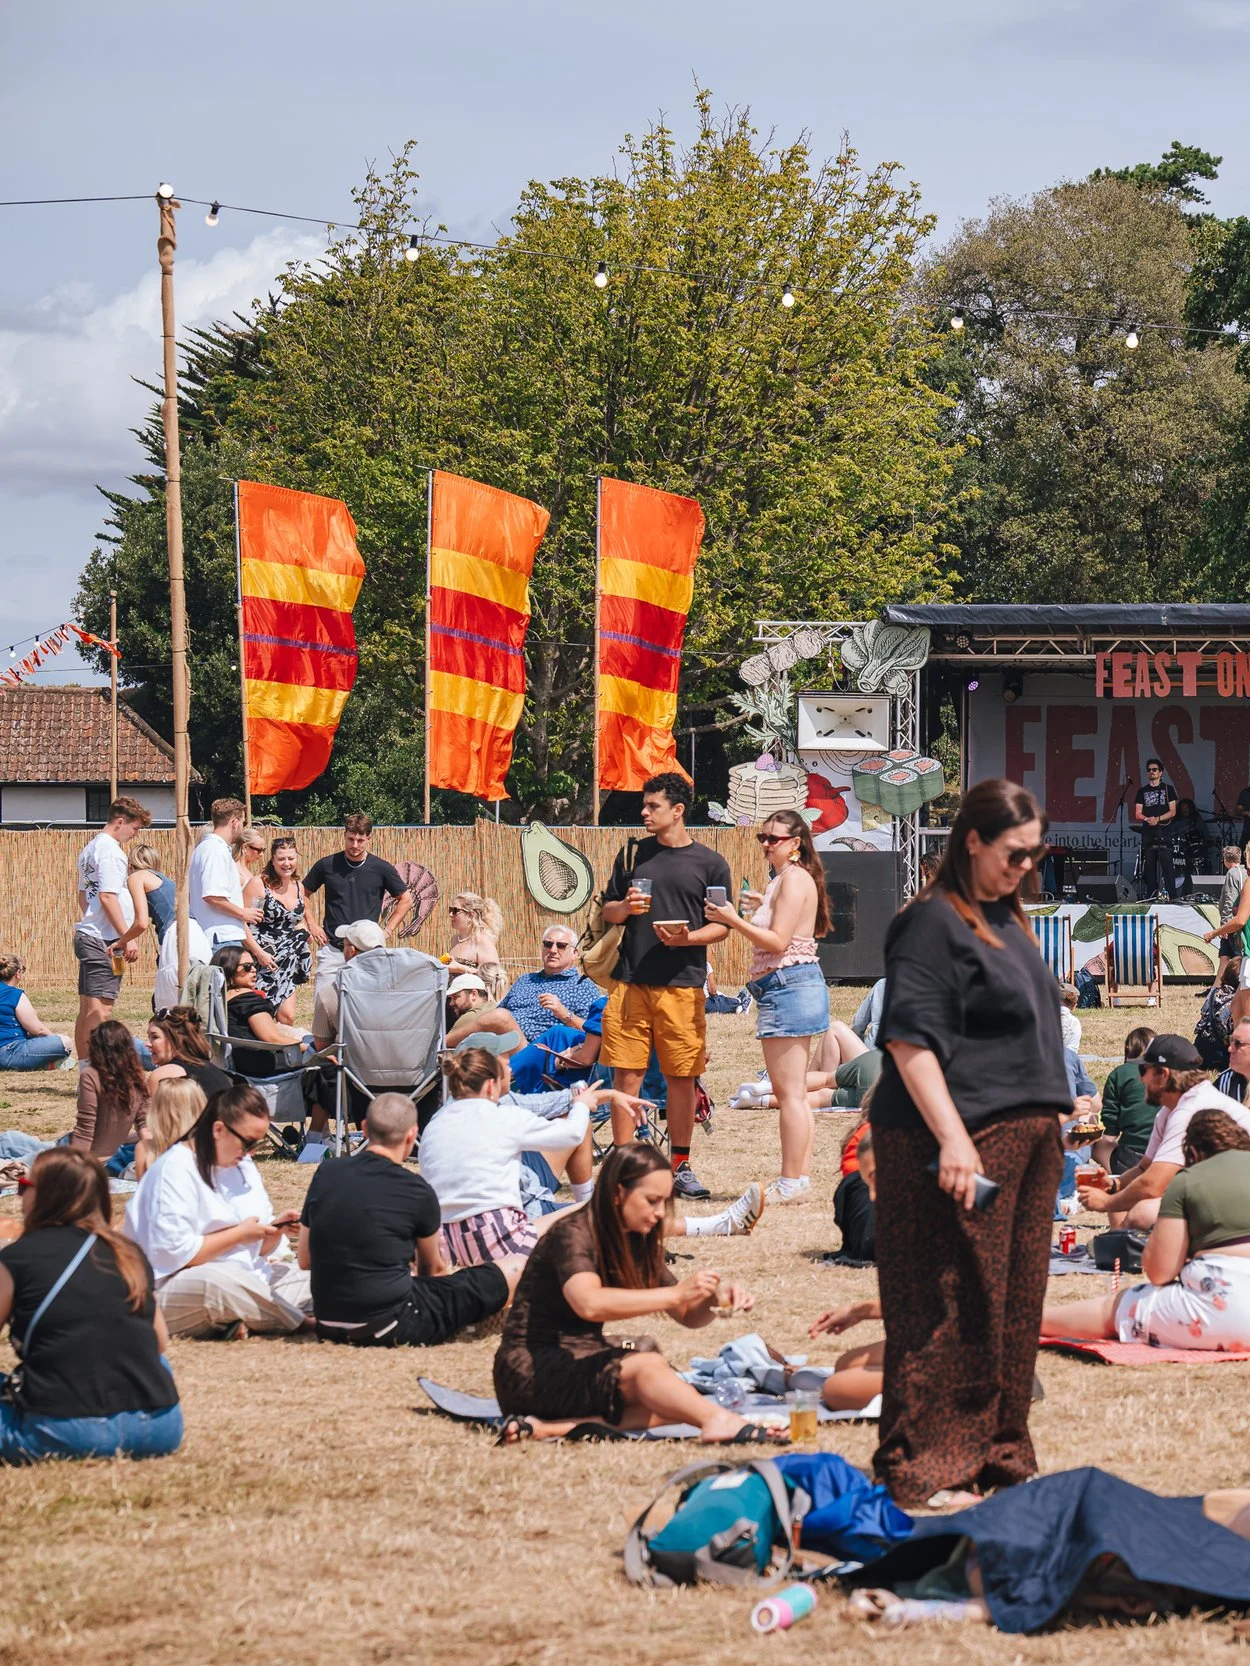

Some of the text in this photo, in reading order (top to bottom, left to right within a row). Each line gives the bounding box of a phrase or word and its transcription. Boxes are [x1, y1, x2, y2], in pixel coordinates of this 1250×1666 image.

[1095, 651, 1203, 698] FEAST
[1055, 833, 1079, 847] into
[1081, 833, 1102, 848] the
[1104, 833, 1137, 848] heart
